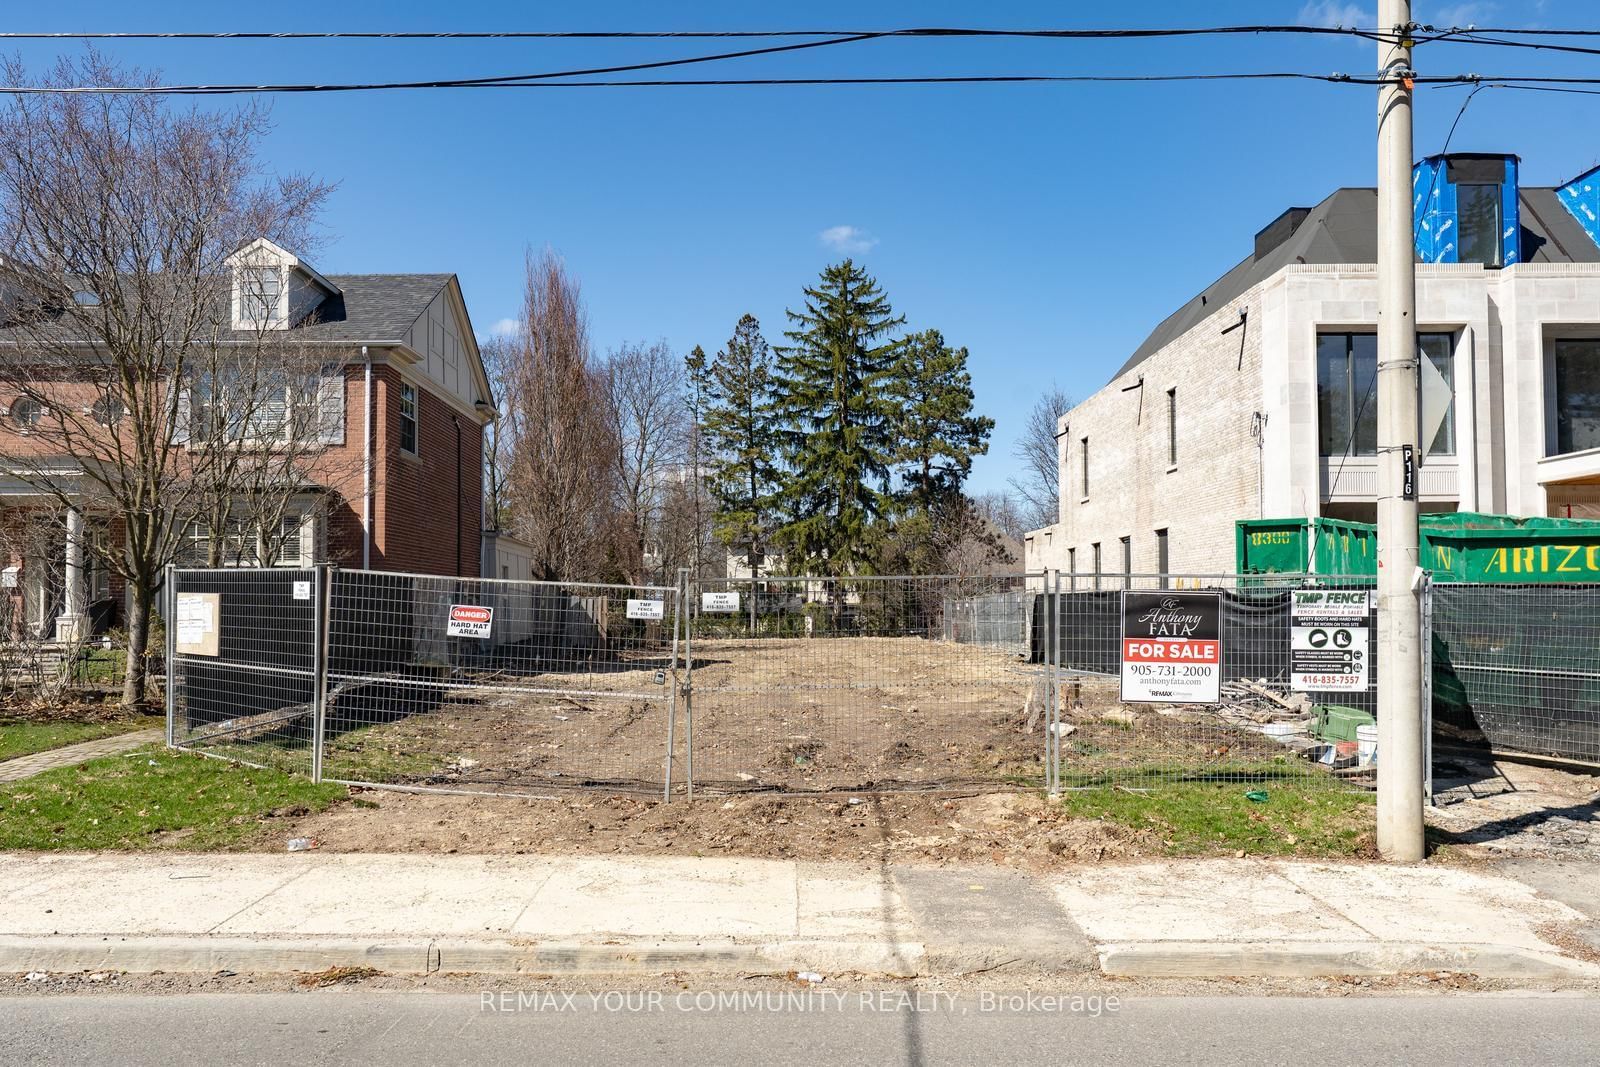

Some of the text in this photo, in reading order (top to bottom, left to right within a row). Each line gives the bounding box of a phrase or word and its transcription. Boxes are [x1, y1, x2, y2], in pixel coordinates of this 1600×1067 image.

[1405, 450, 1413, 494] P116
[1295, 593, 1366, 604] TMP FENCE
[453, 610, 488, 619] DANGER
[1138, 607, 1203, 631] Anthony
[451, 621, 471, 629] HARD
[1149, 622, 1192, 636] FATA
[1128, 643, 1215, 659] FOR SALE
[1130, 664, 1212, 678] 905-731-2000
[1139, 677, 1202, 687] anthonyfata.com
[1302, 675, 1360, 684] 416-835-7557
